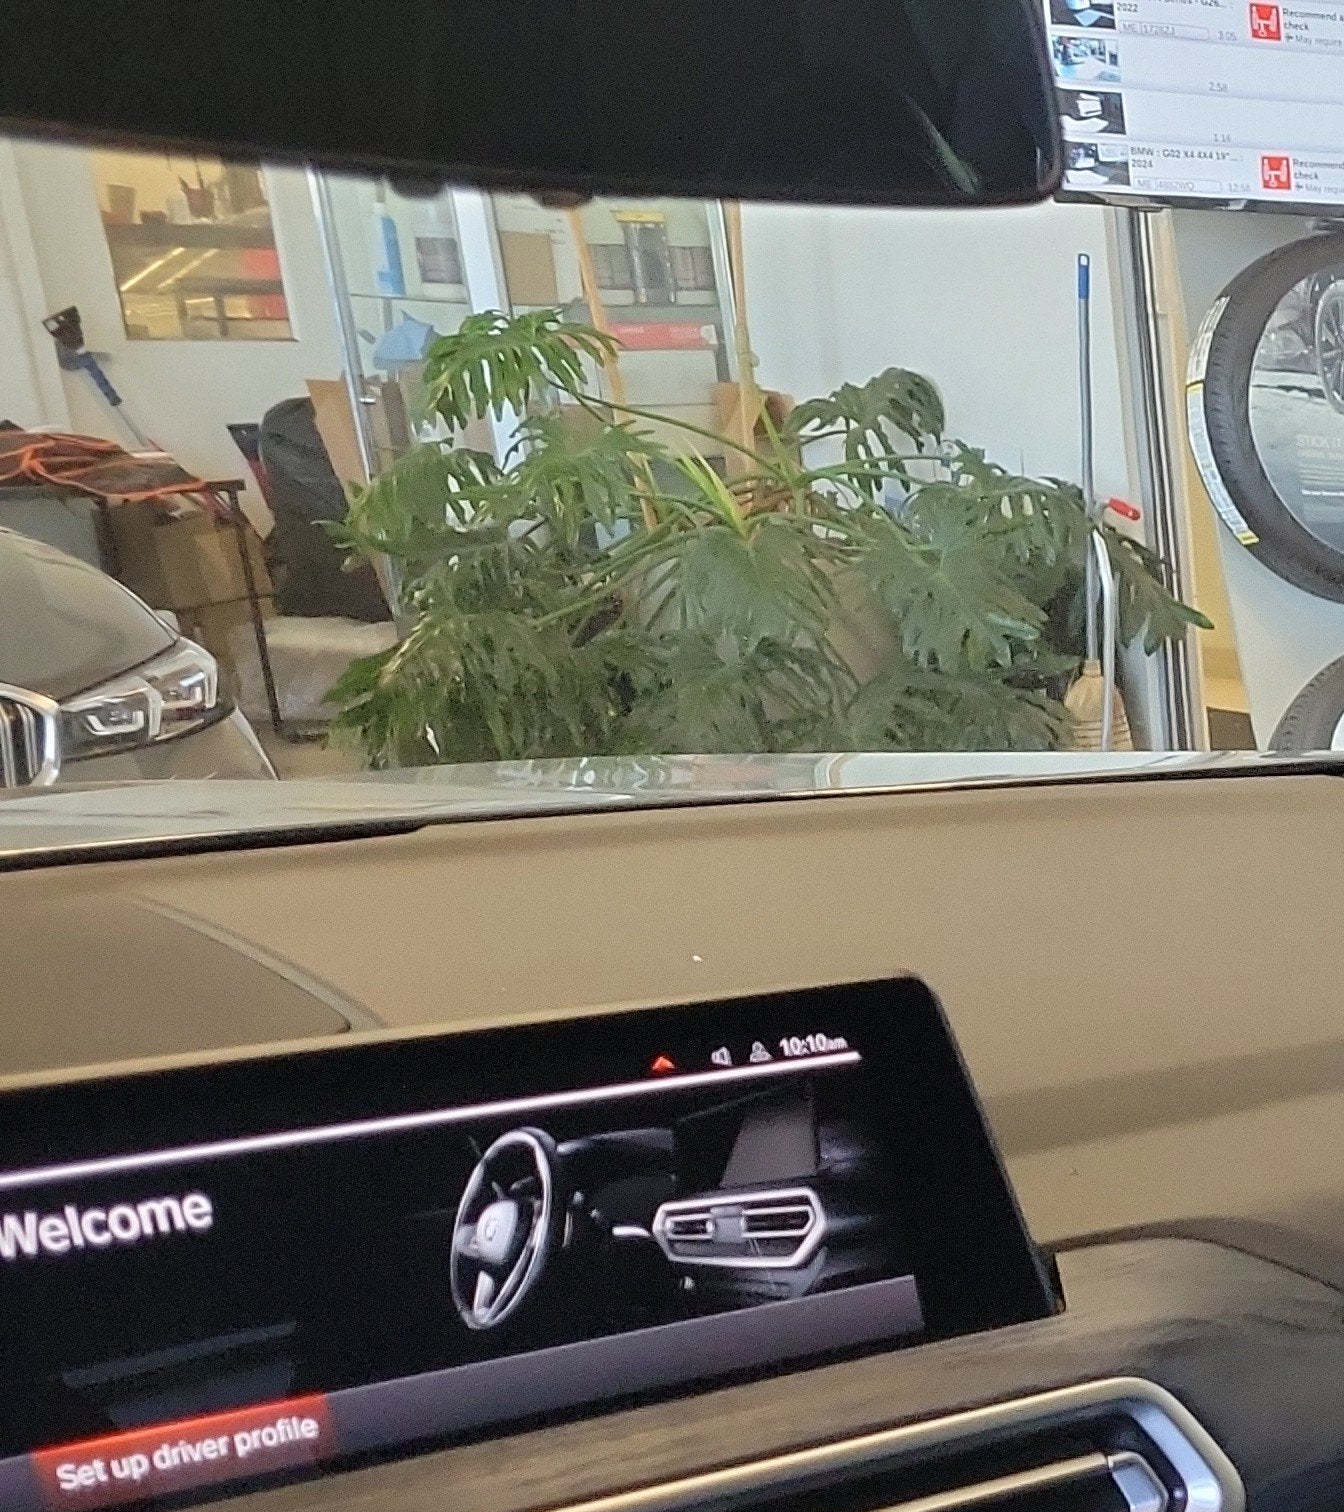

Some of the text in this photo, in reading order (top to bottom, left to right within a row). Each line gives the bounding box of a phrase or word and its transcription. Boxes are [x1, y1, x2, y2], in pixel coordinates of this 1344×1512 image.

[1117, 3, 1139, 13] 2022
[1282, 7, 1337, 22] Recommend
[1284, 22, 1309, 32] check
[1295, 34, 1312, 46] May
[1314, 37, 1342, 49] require
[1130, 146, 1154, 157] BMW
[1131, 158, 1153, 168] 2024
[1293, 171, 1319, 181] check
[1305, 183, 1322, 194] May
[0, 1190, 214, 1260] Welcome
[55, 1416, 319, 1491] Set up driver profile
